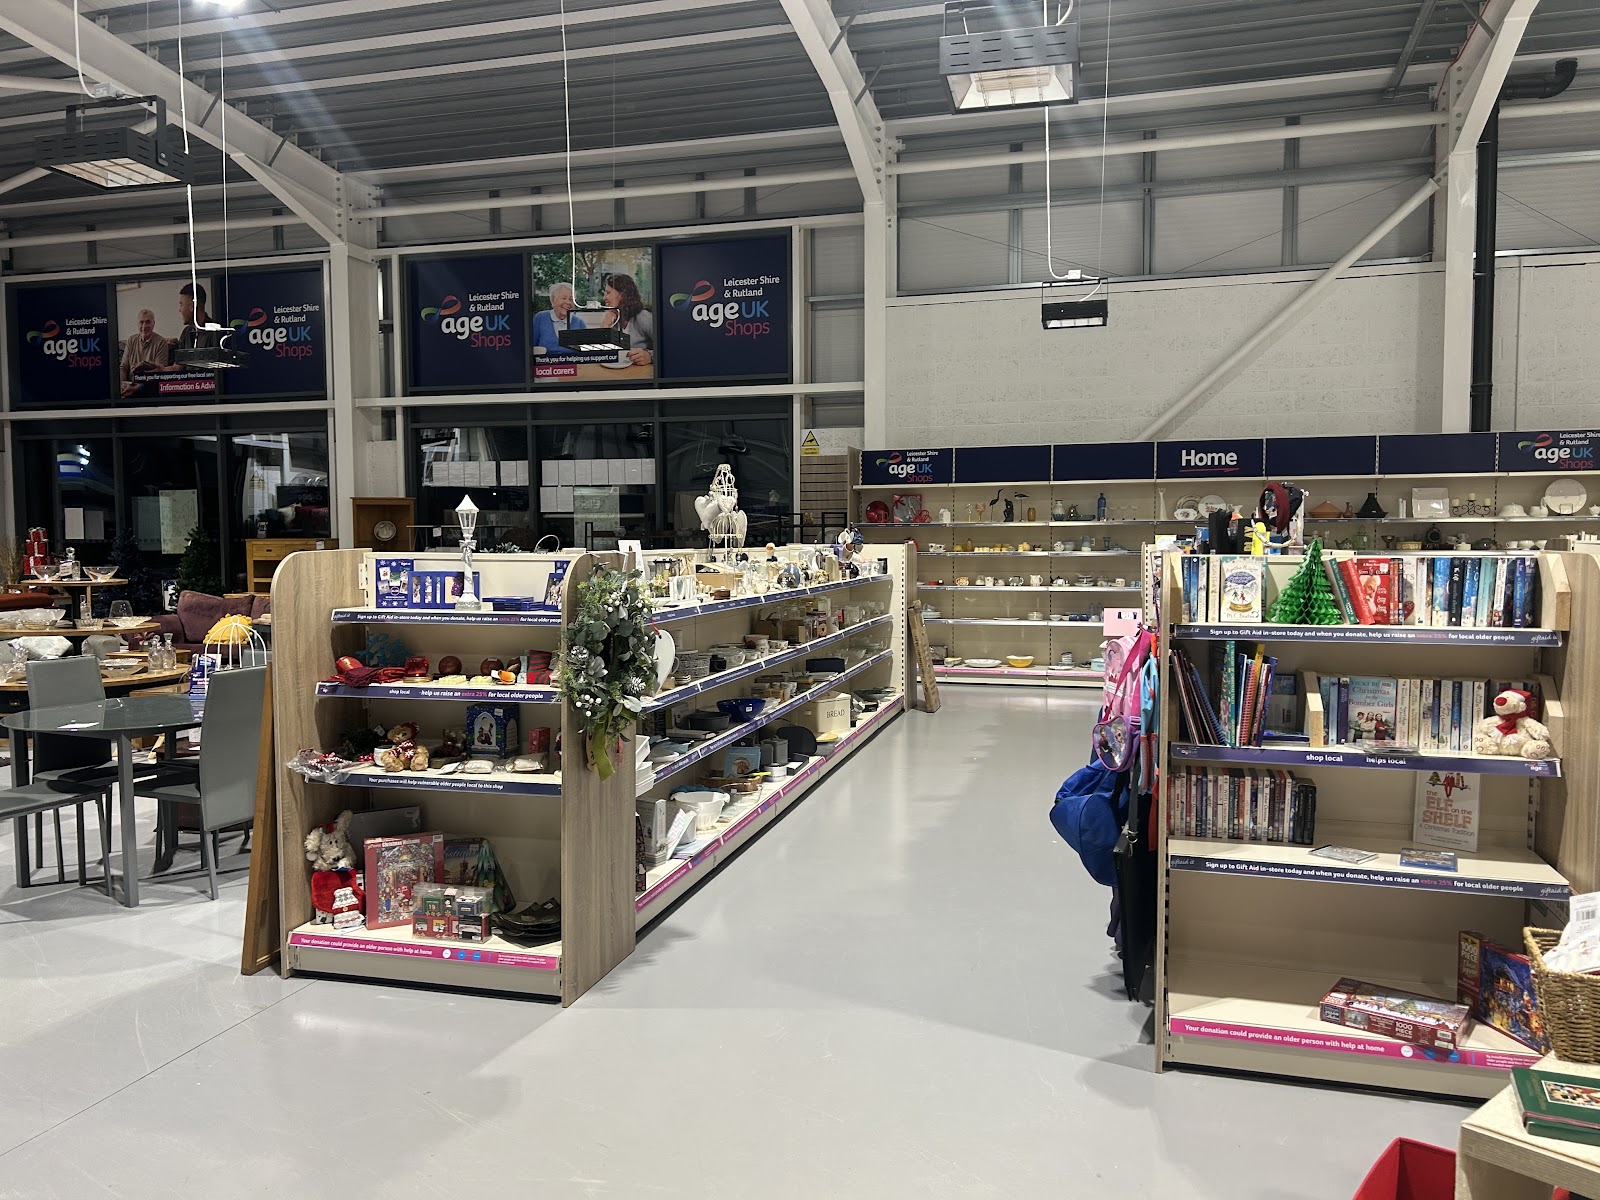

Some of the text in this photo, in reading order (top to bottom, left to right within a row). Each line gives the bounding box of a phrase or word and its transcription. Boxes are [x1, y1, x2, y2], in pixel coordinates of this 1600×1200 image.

[724, 275, 779, 286] Leicester Shire
[469, 291, 519, 301] Leicester Shire
[724, 287, 762, 298] & Rutland
[469, 302, 504, 312] & Rutland
[281, 314, 306, 323] Rutland
[692, 300, 769, 327] age UK
[65, 316, 107, 326] Leicester Shire
[73, 327, 95, 335] Rutland
[441, 314, 510, 340] age UK
[725, 320, 770, 339] Shops
[249, 326, 311, 350] age UK
[470, 333, 511, 350] Shops
[44, 338, 100, 360] age UK
[276, 343, 312, 360] Shops
[68, 354, 102, 369] Shops
[566, 355, 583, 363] helping
[536, 367, 574, 375] local carers
[160, 383, 194, 391] Information
[1181, 449, 1237, 466] Home
[1534, 447, 1593, 463] age UK
[1559, 459, 1593, 470] Shops
[889, 463, 932, 478] age UK
[907, 474, 933, 482] Shops
[1352, 686, 1389, 695] Christmas
[1349, 699, 1394, 708] Bomber Girls
[826, 709, 845, 718] BREAD
[1306, 754, 1323, 762] shop
[1366, 756, 1406, 765] helps local
[1426, 796, 1453, 812] ELF
[1422, 810, 1472, 829] SHELF
[1424, 824, 1474, 836] Christmas Tradition
[1285, 868, 1302, 876] today
[1346, 872, 1370, 880] donate,
[1371, 874, 1384, 882] help
[1501, 885, 1523, 893] people
[1540, 887, 1562, 897] giftaid
[1461, 941, 1477, 956] 1000
[1461, 950, 1477, 962] PIECE
[1395, 1021, 1413, 1030] 1000
[1395, 1028, 1413, 1036] PIECE
[1200, 1026, 1228, 1035] donation
[1248, 1032, 1272, 1040] provide
[1302, 1038, 1323, 1046] person
[1341, 1042, 1355, 1050] help
